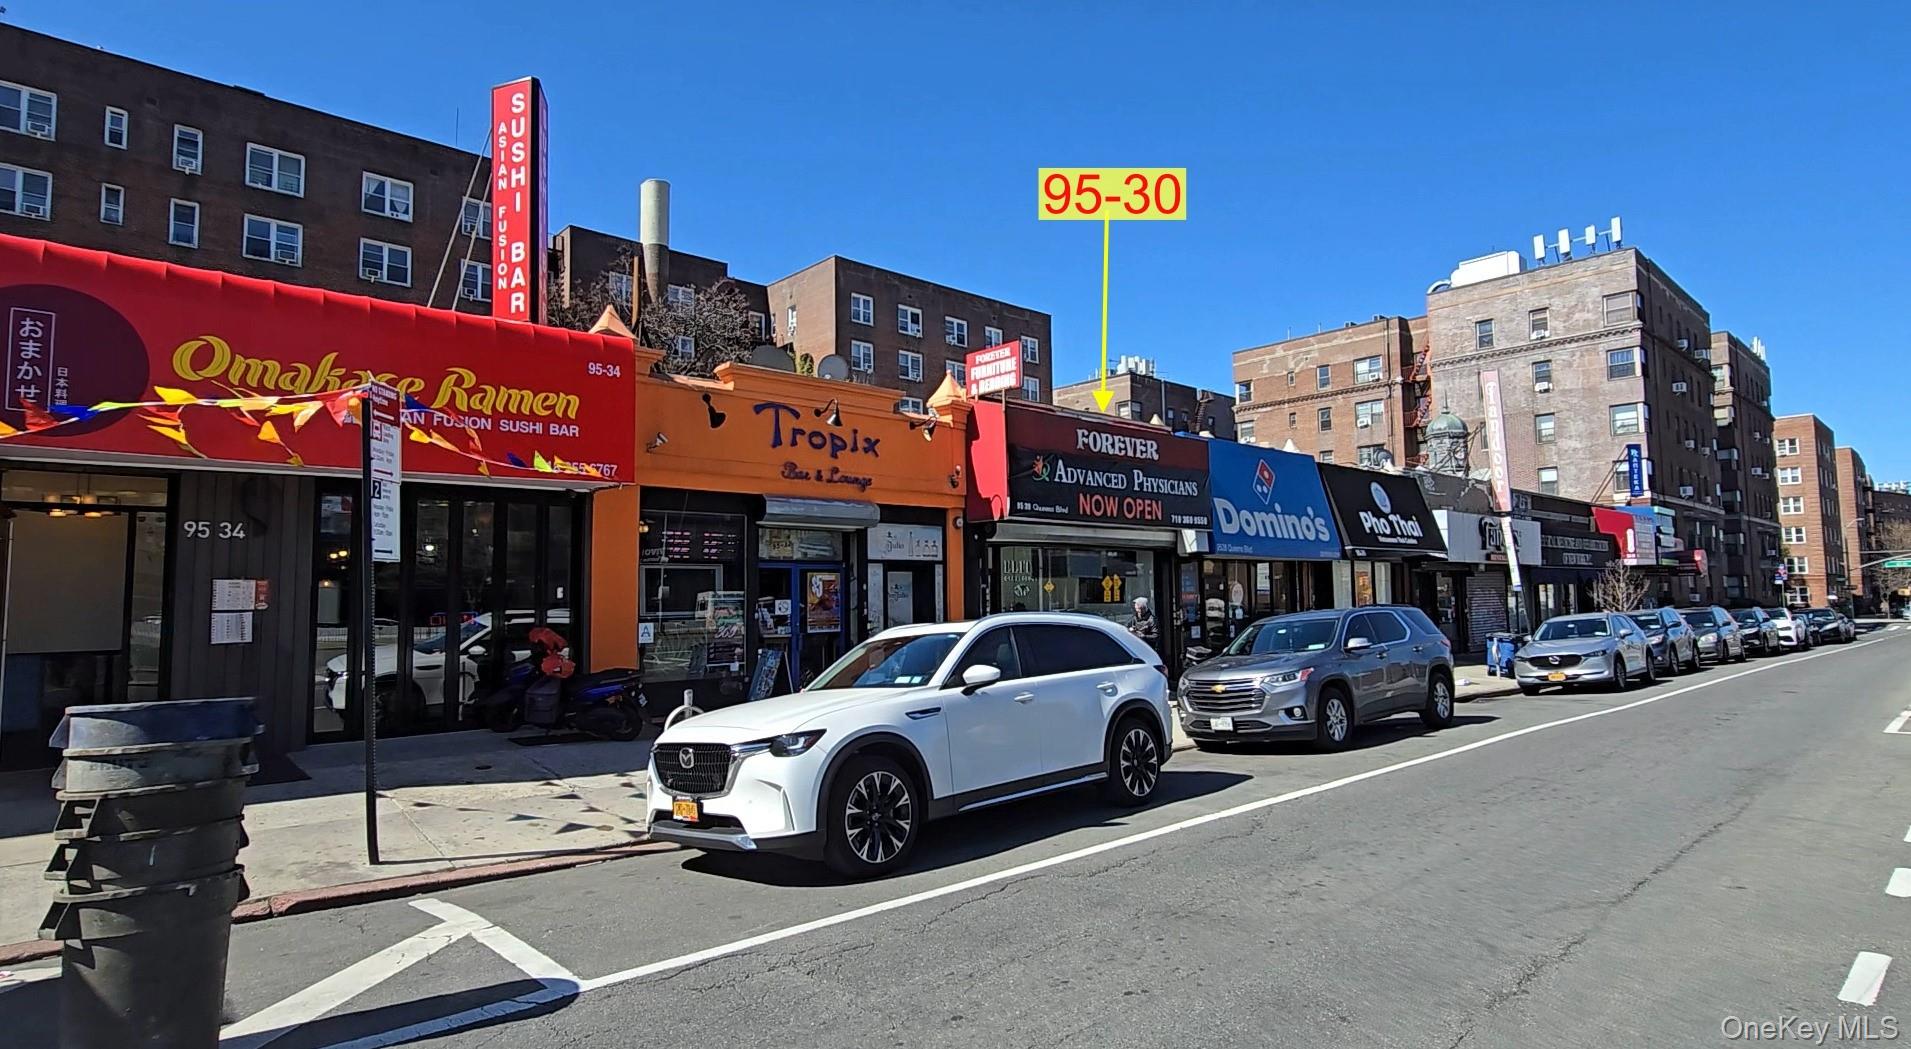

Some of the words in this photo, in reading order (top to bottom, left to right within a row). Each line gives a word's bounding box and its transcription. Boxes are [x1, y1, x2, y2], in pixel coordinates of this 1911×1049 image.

[497, 122, 508, 190] ASIAN
[511, 92, 526, 213] SUSHI
[497, 206, 508, 290] FUSION
[510, 241, 526, 315] BAR
[15, 317, 45, 403] おまかせ
[587, 361, 621, 378] 95-34
[970, 356, 1017, 381] FURNITURE
[433, 367, 580, 419] Ramen
[433, 414, 492, 431] FUSION
[499, 419, 543, 436] SUSHI
[549, 423, 580, 438] BAR
[753, 402, 881, 459] Tropix
[1076, 428, 1160, 462] FOREVER
[1078, 492, 1119, 518] NOW
[1123, 497, 1163, 521] OPEN
[1213, 497, 1331, 543] Domino's
[1359, 510, 1391, 535] Pho
[1388, 513, 1424, 537] Thai
[183, 521, 211, 538] 95
[219, 522, 246, 539] 34
[641, 625, 651, 637] A
